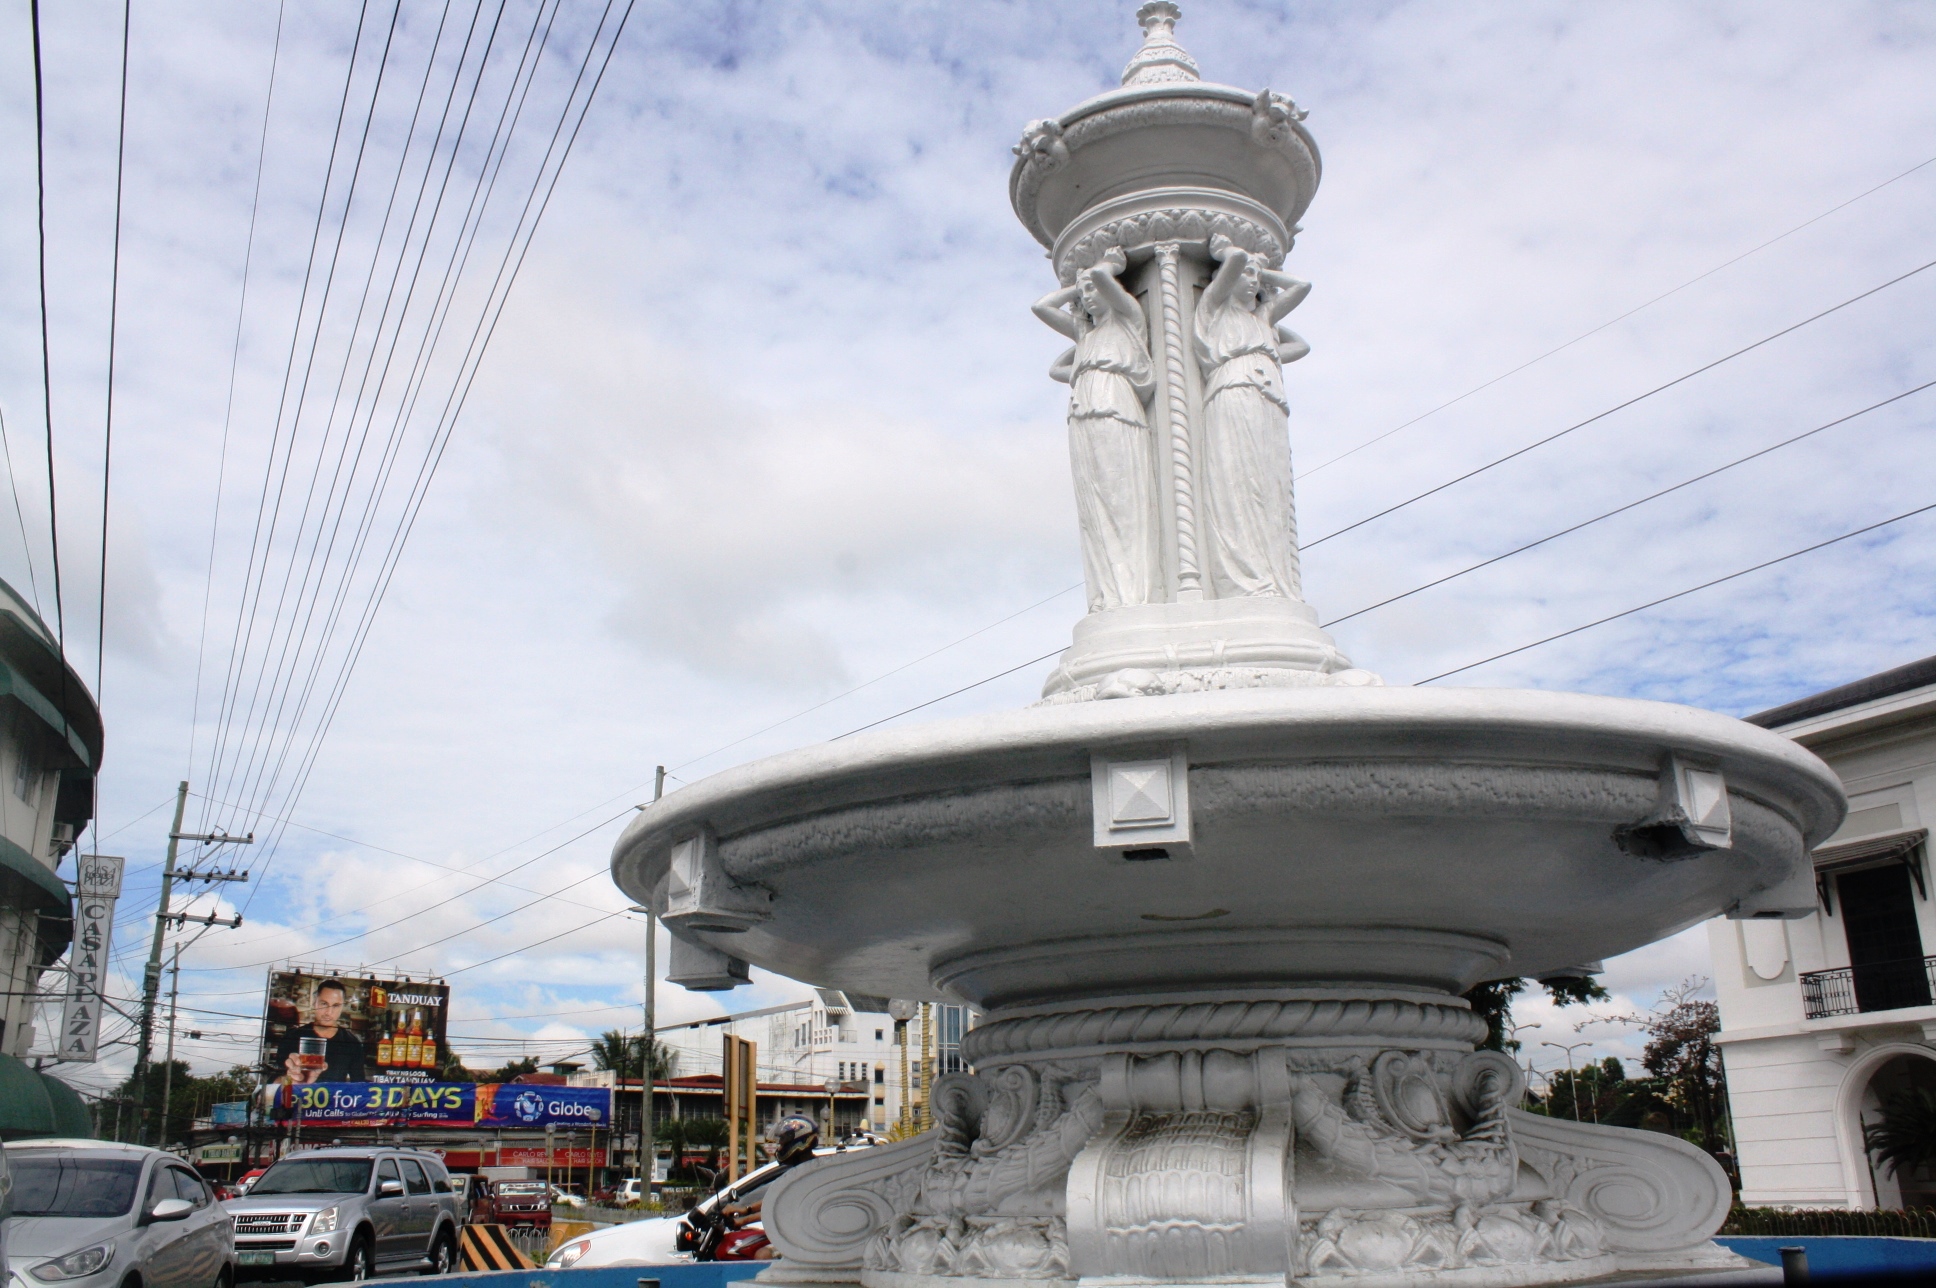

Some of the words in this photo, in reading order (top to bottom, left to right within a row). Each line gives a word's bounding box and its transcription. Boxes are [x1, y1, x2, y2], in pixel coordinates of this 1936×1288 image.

[78, 904, 106, 967] CASA
[388, 993, 443, 1006] TANDUAY
[68, 972, 98, 1053] PLAZA
[373, 1075, 395, 1083] TIBAY
[333, 1089, 362, 1108] for
[366, 1087, 383, 1108] 3
[386, 1087, 462, 1109] DAYS
[305, 1109, 323, 1117] Unli
[324, 1108, 344, 1117] Calls
[413, 1111, 438, 1119] Surfing
[548, 1101, 592, 1116] Globe
